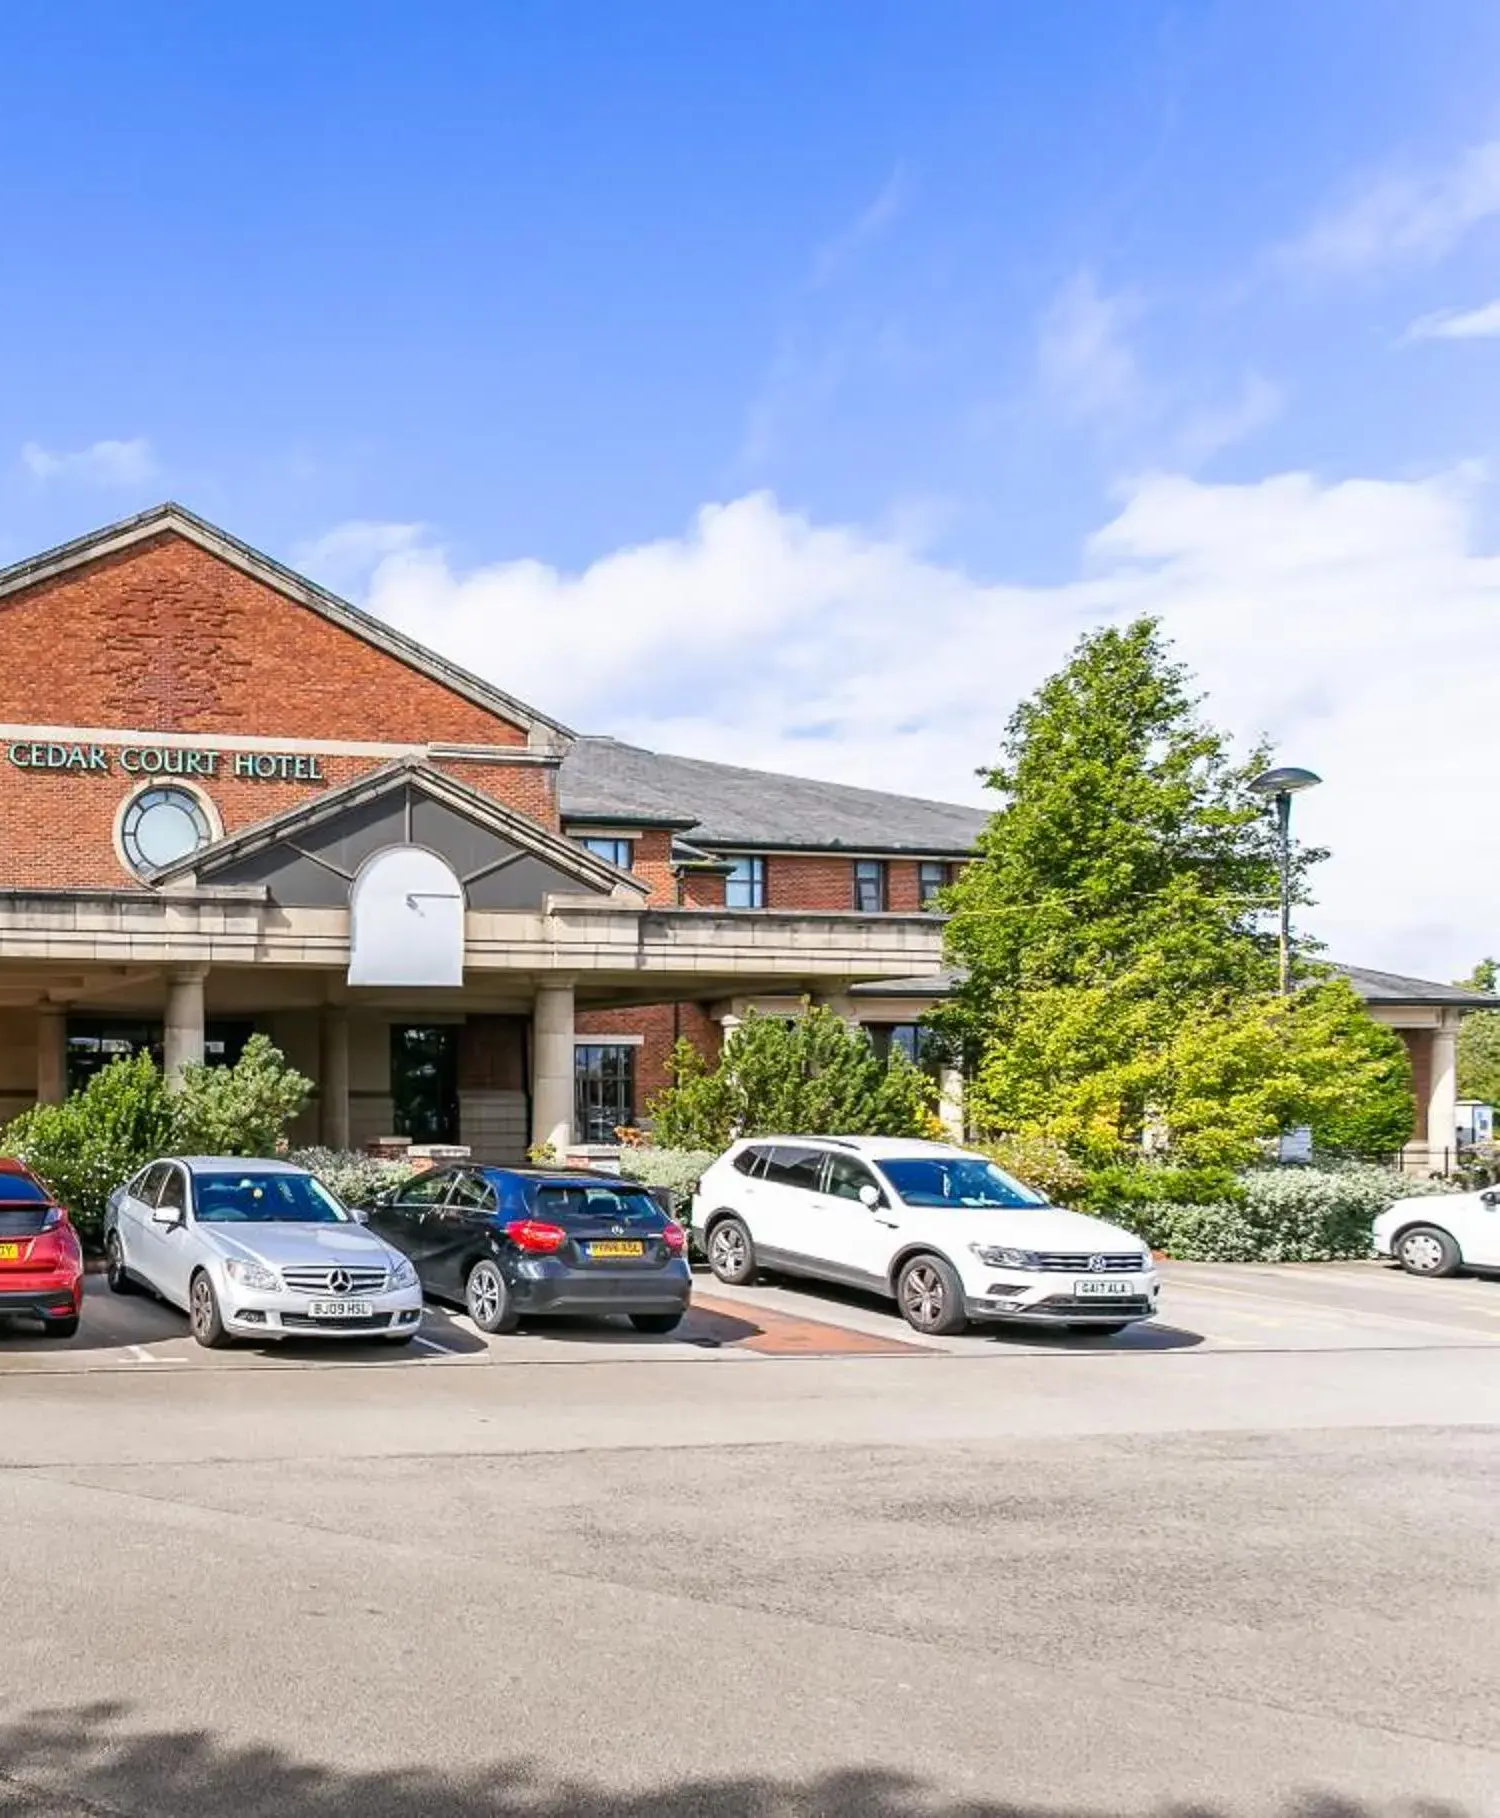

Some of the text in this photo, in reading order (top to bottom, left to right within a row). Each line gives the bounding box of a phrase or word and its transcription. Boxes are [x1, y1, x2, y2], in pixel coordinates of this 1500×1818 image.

[8, 742, 324, 780] CEDAR COURT HOTEL
